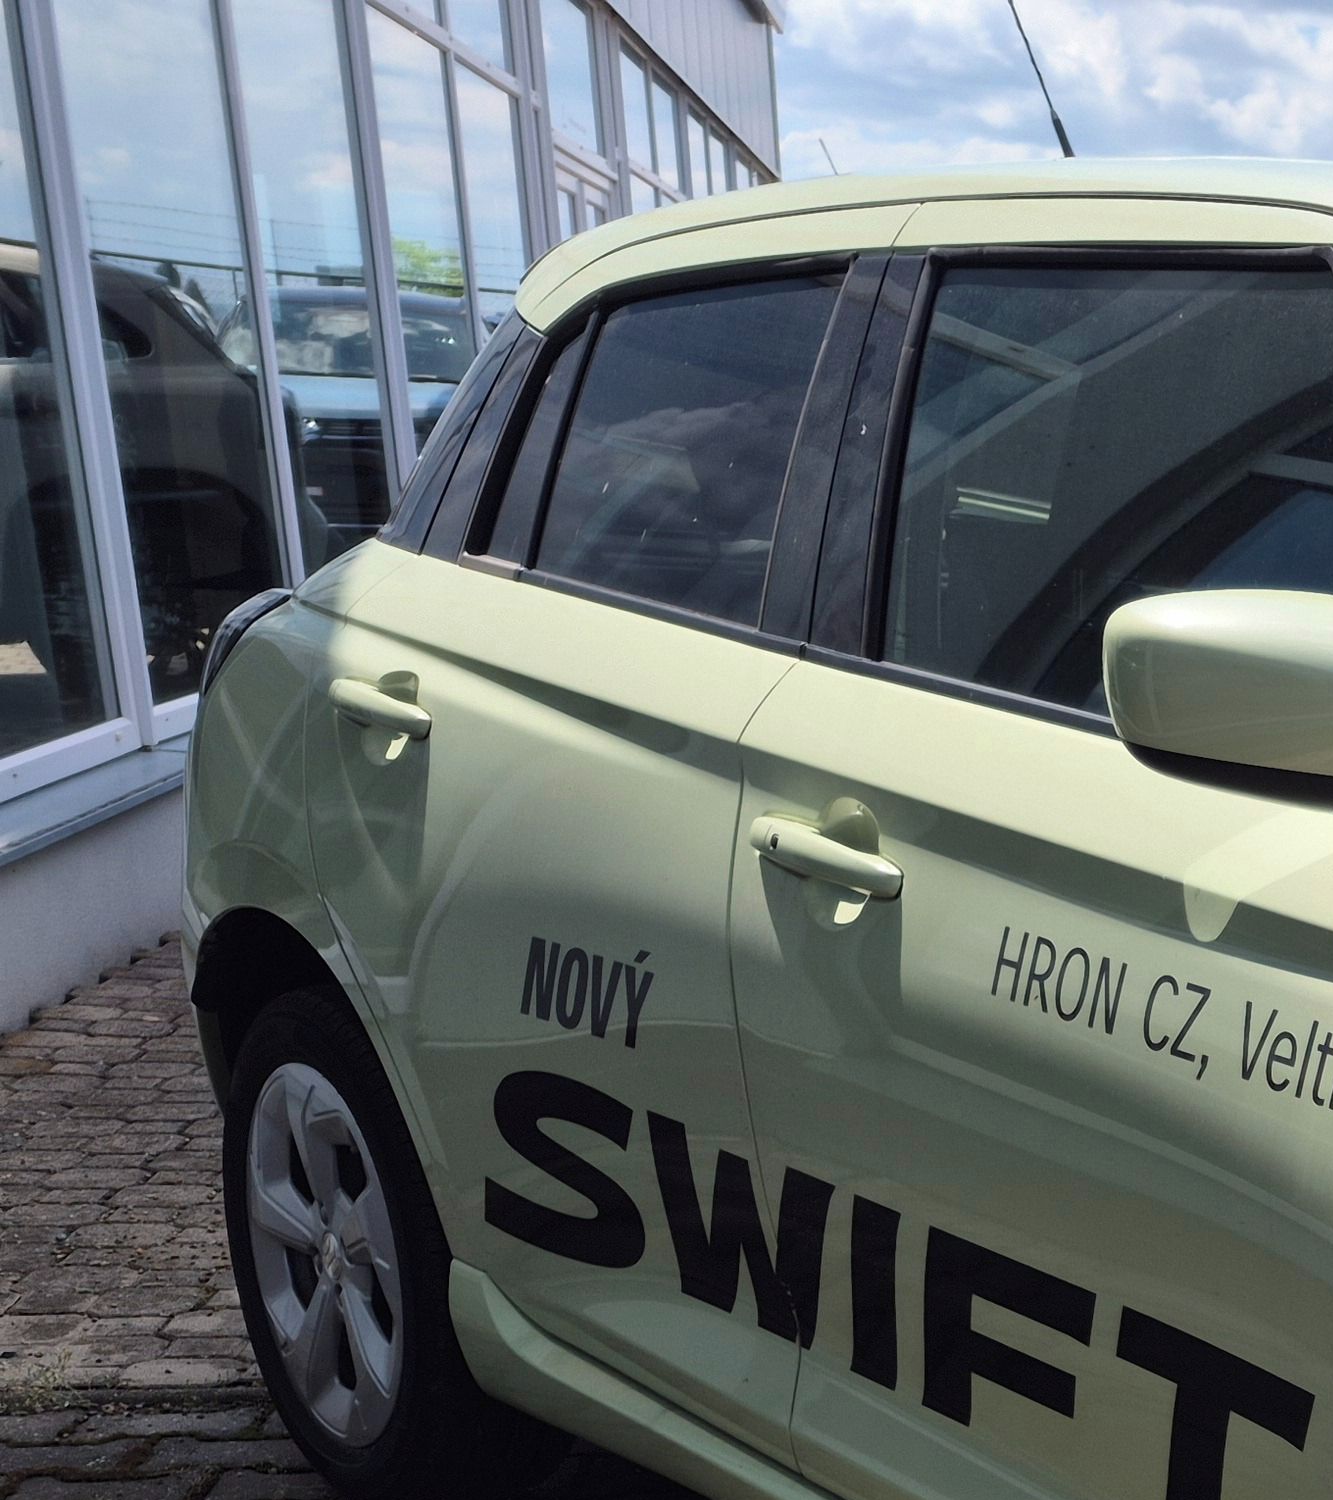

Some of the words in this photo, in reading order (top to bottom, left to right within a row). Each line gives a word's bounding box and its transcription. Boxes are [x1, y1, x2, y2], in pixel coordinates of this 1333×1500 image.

[520, 936, 655, 1050] NOVÝ
[991, 926, 1128, 1035] HRON
[1143, 974, 1212, 1081] CZ,
